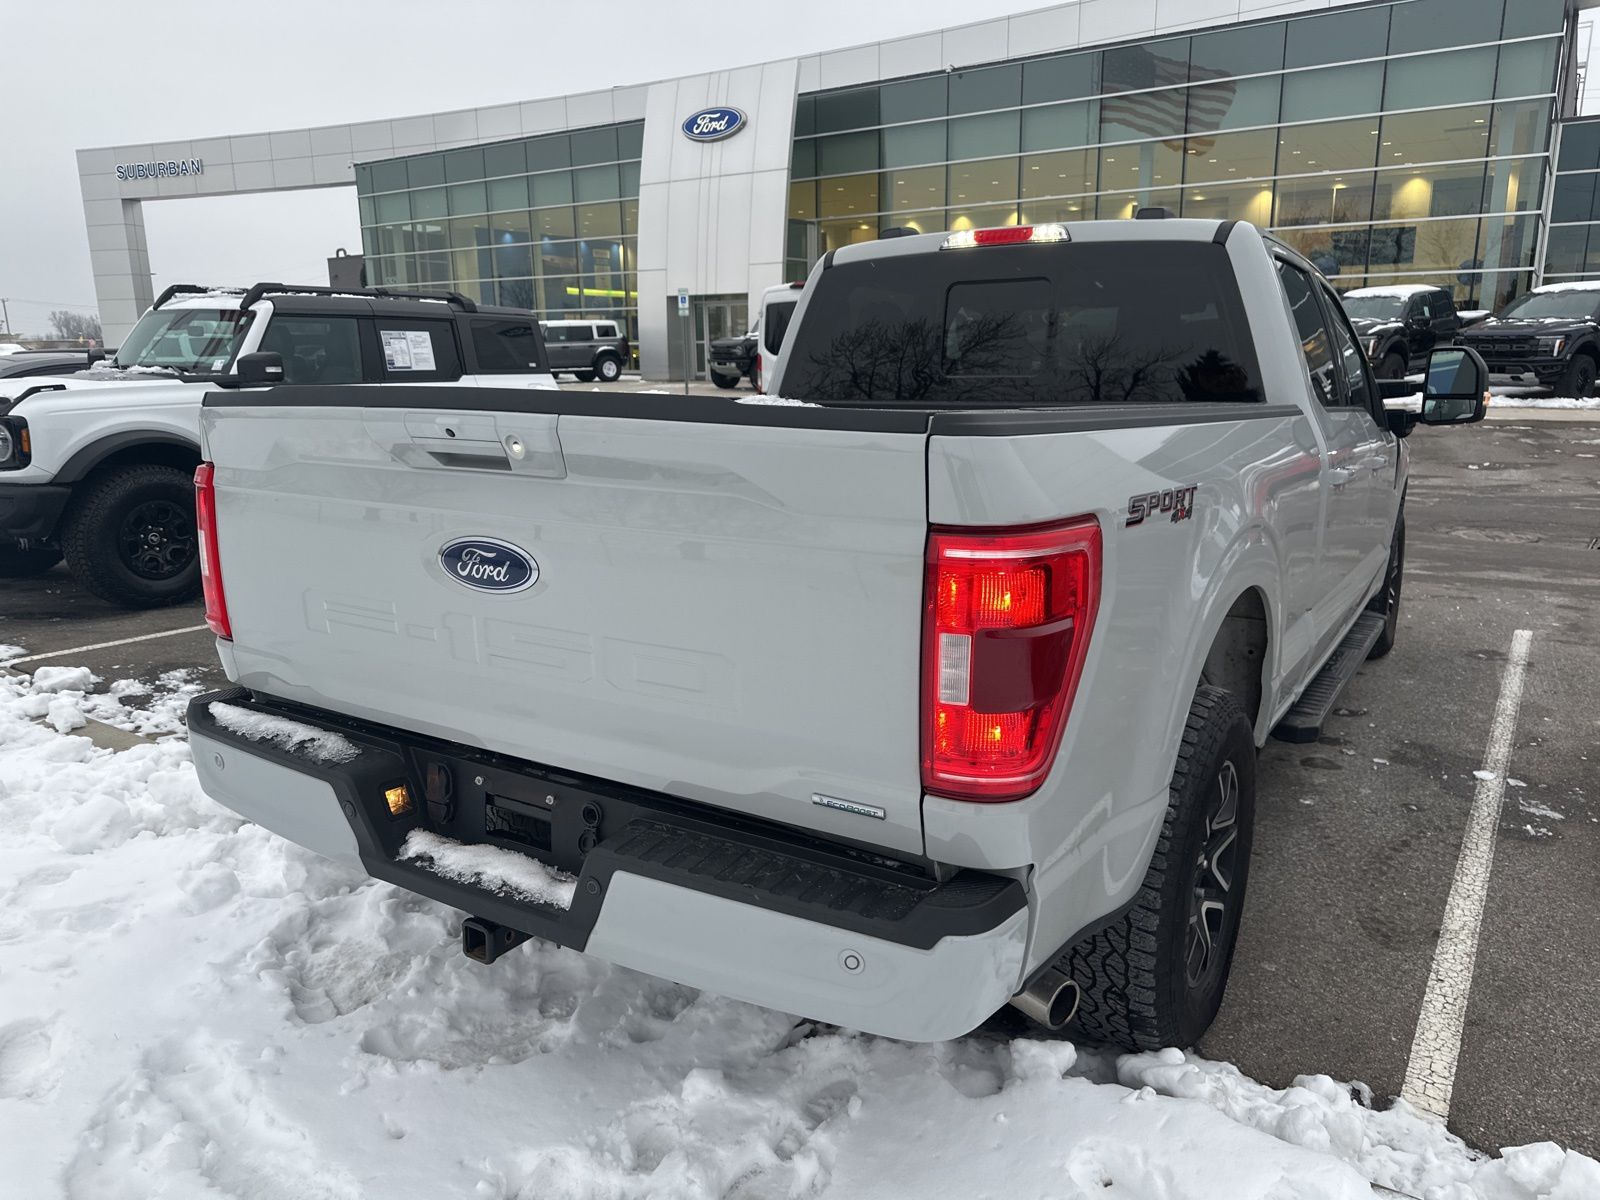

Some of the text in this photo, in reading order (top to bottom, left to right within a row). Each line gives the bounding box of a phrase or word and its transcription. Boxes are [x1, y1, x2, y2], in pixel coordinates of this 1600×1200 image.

[693, 113, 729, 134] Ford
[115, 158, 203, 181] SUBURBAN
[1125, 483, 1198, 529] SPORT
[457, 547, 510, 582] Ford
